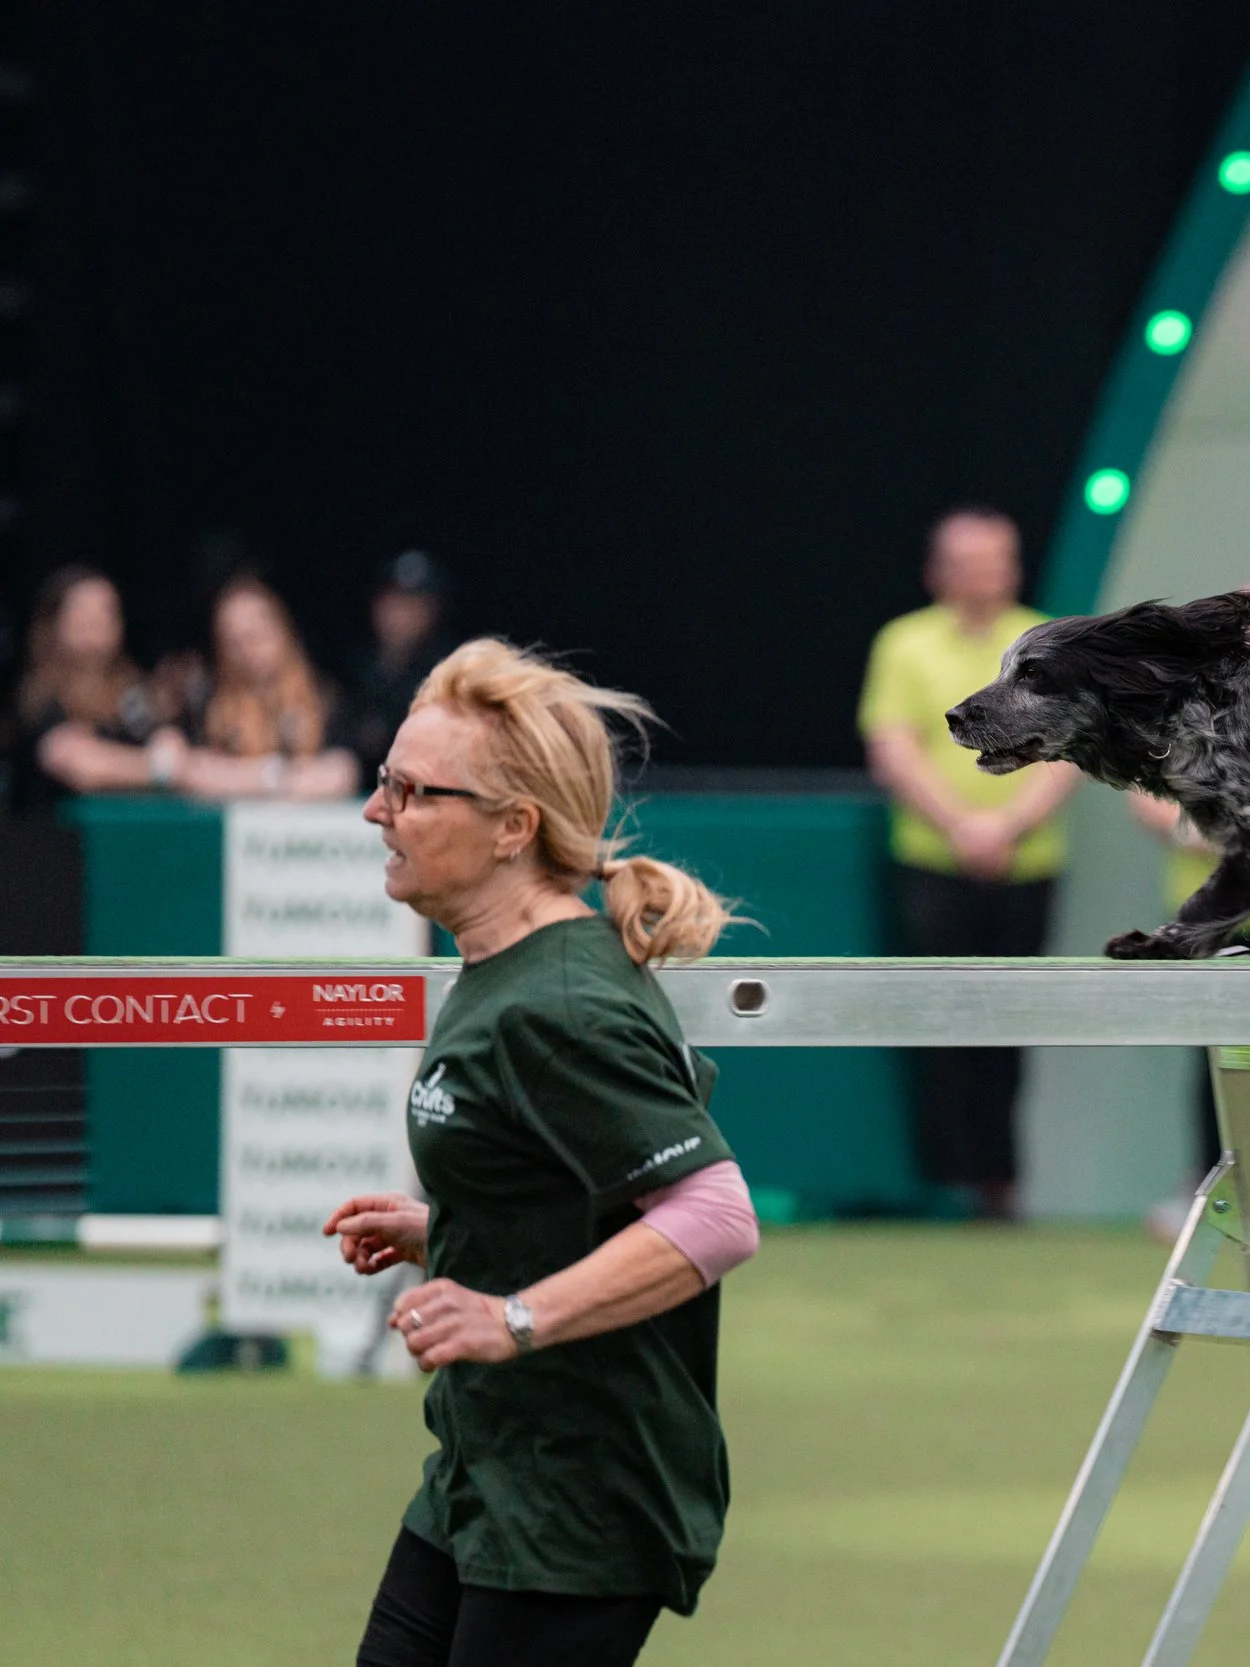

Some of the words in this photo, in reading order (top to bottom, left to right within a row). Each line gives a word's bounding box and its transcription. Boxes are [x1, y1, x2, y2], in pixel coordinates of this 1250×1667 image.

[313, 984, 406, 1003] NAYLOR
[64, 994, 253, 1025] CONTACT
[322, 1017, 396, 1027] AGILITY
